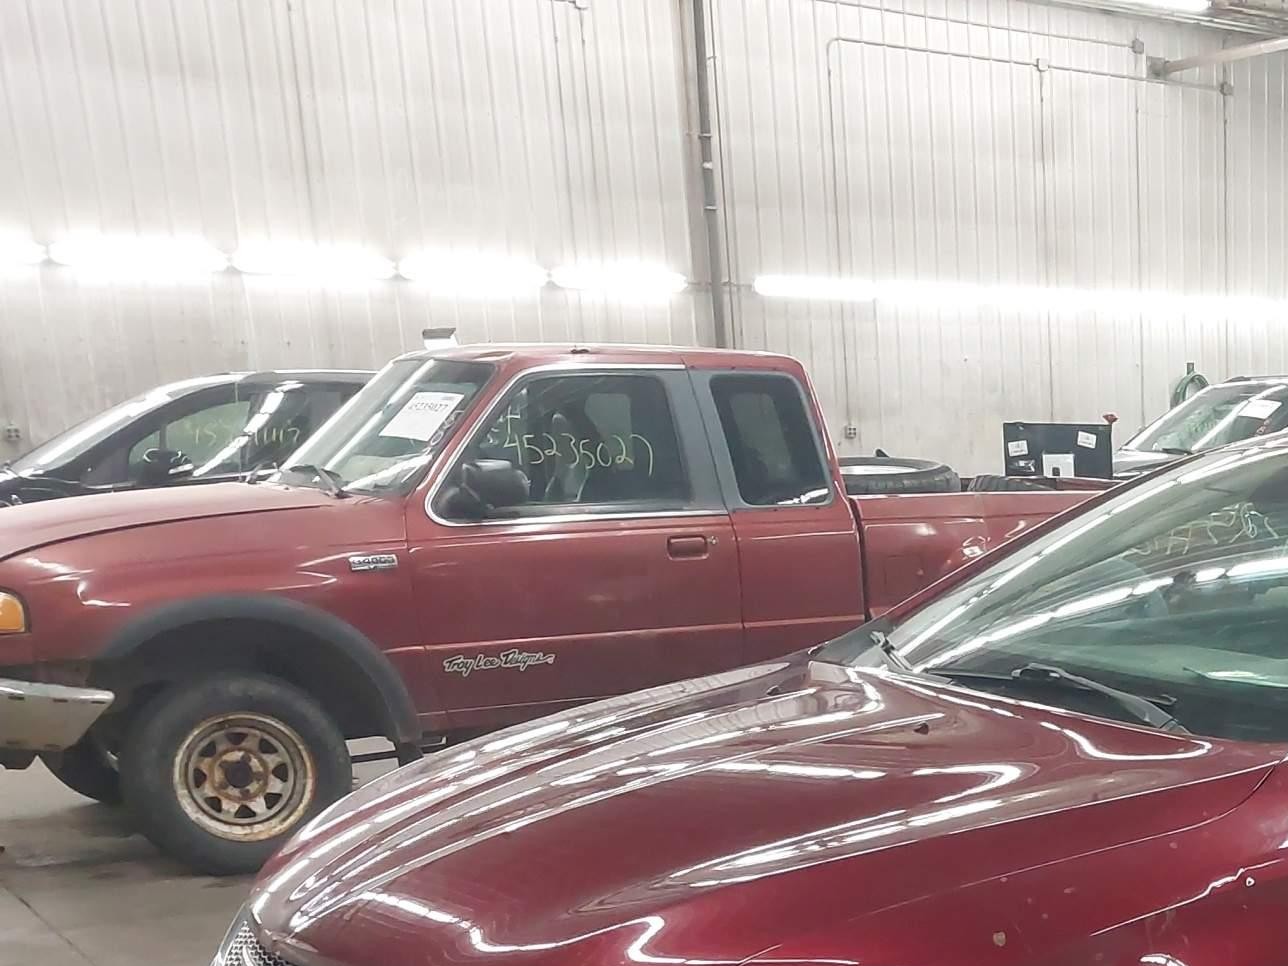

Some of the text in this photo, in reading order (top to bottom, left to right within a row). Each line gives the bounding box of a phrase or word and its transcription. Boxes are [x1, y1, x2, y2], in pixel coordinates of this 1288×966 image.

[503, 433, 654, 477] 45235027
[443, 649, 555, 677] Troy Lee Designs
